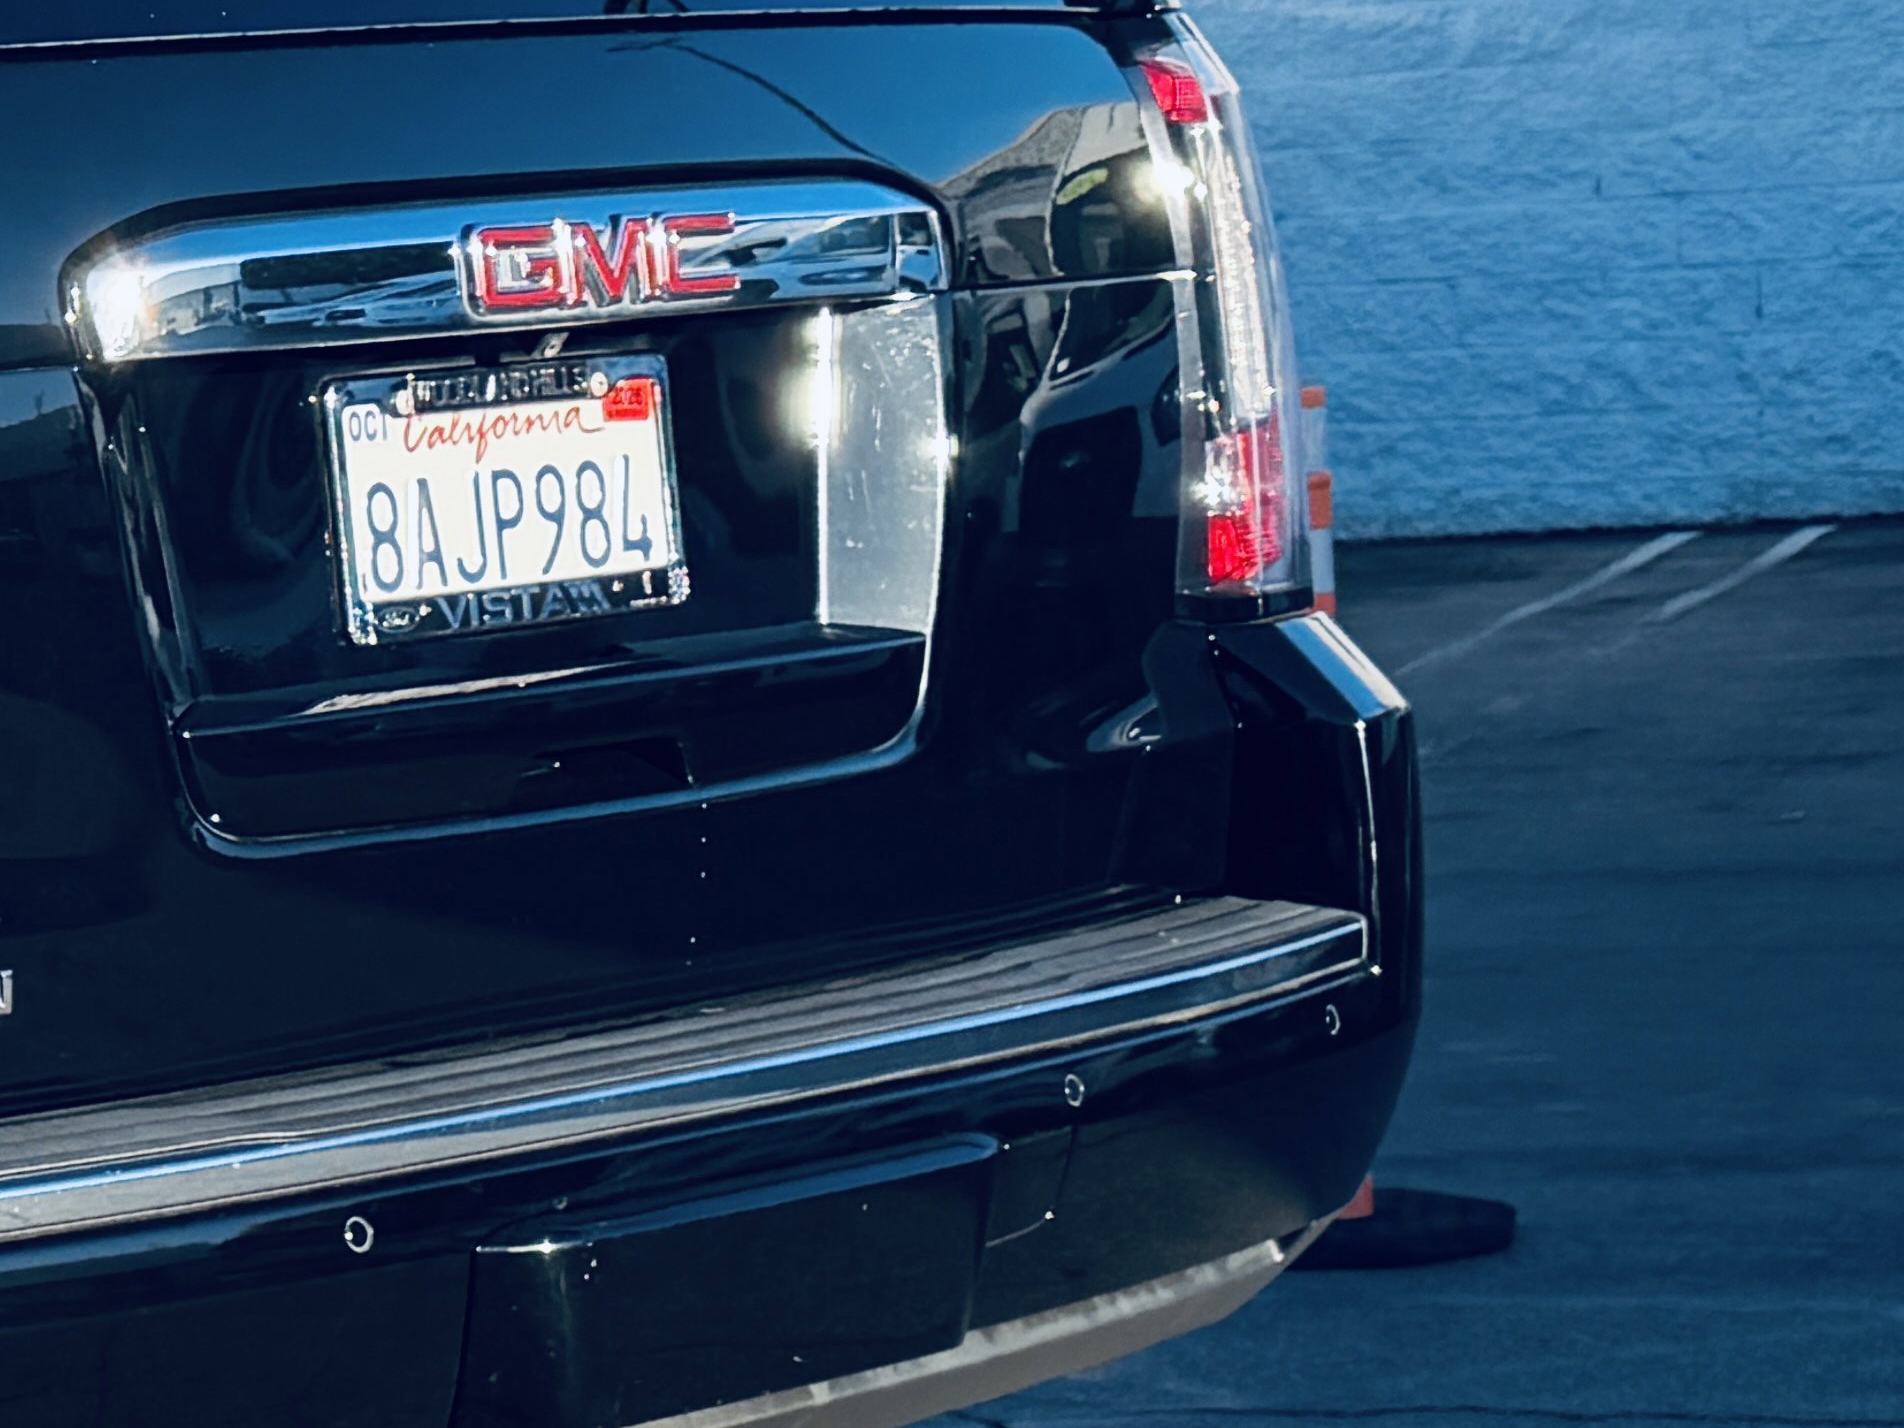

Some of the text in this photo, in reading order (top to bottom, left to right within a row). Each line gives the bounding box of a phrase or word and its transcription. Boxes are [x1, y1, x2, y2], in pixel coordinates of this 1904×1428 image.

[470, 212, 742, 312] GMC
[402, 404, 606, 464] California
[365, 453, 653, 592] 8AJP984
